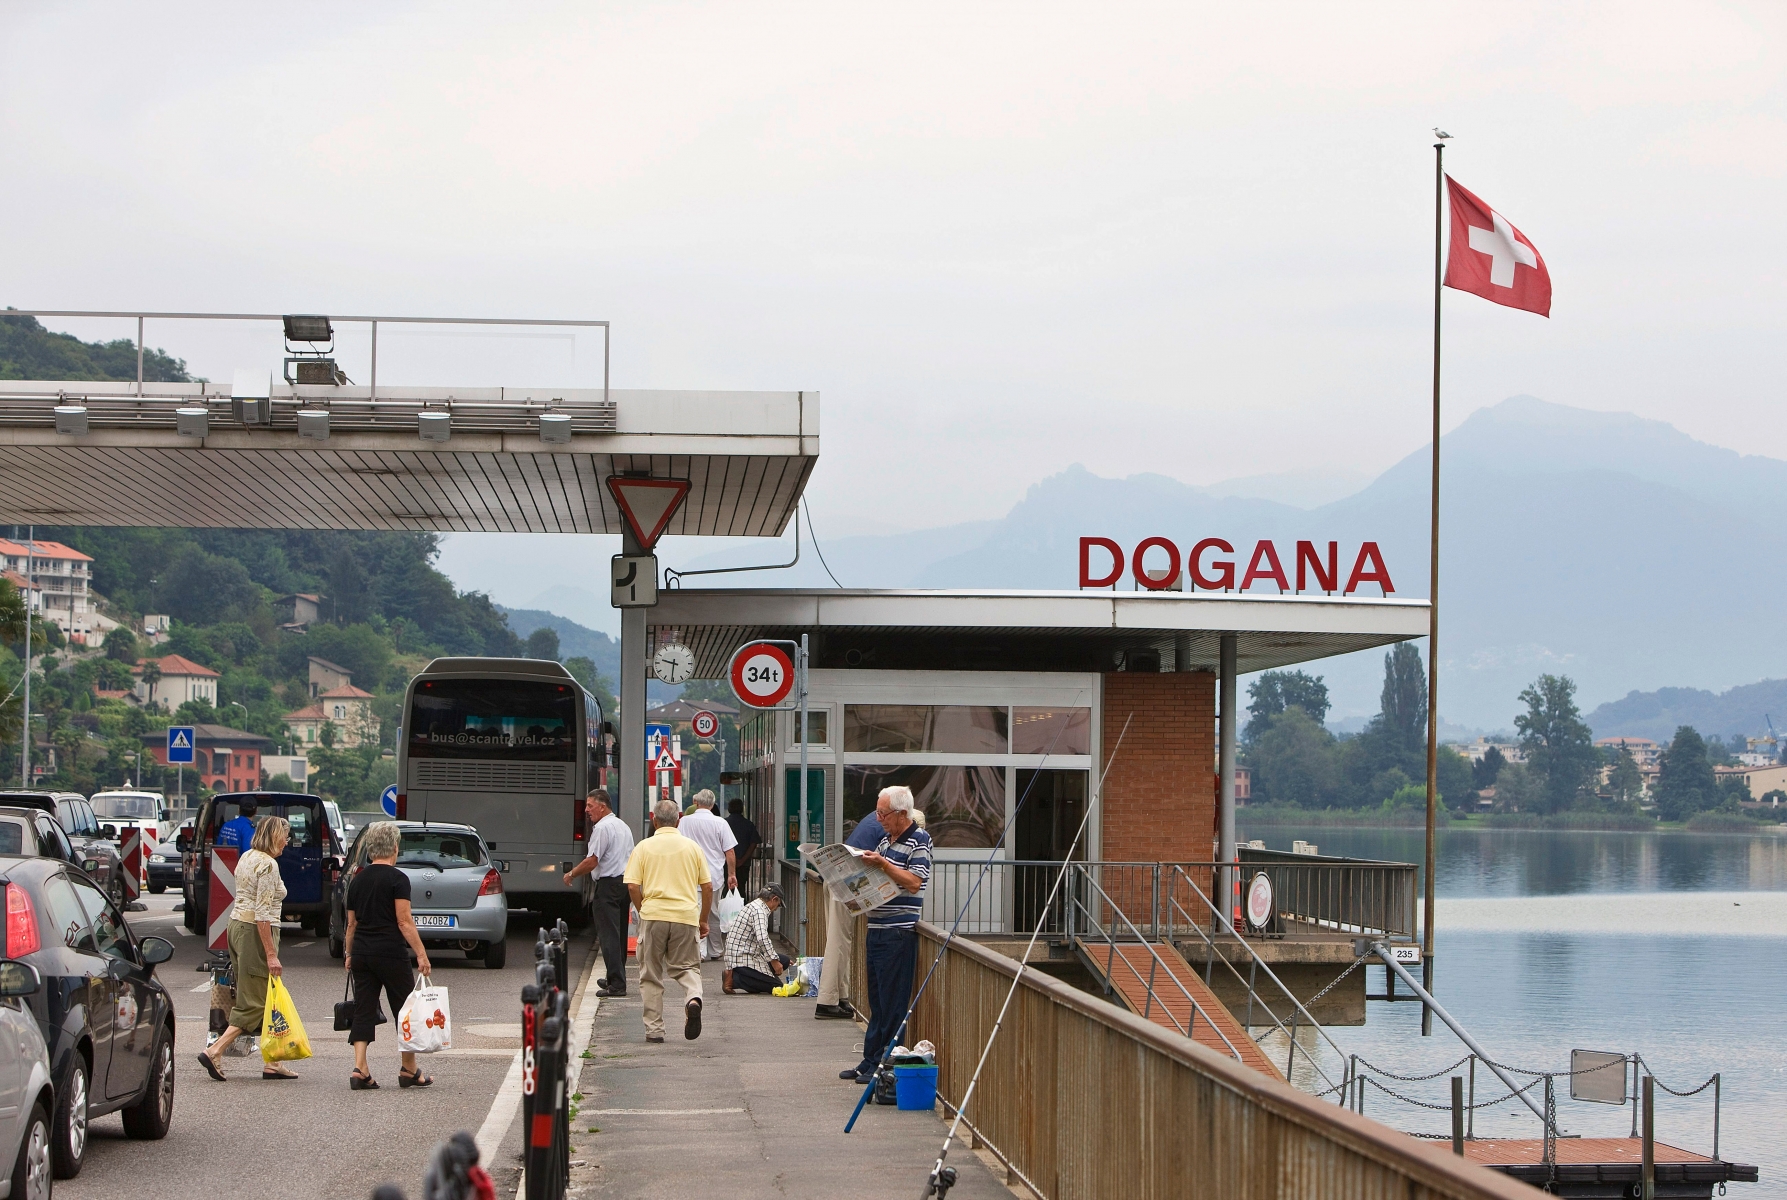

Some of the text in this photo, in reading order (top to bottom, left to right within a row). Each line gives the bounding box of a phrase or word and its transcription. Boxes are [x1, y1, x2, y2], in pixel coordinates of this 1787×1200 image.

[1079, 536, 1396, 593] DOGANA
[699, 719, 711, 729] 50
[431, 732, 555, 746] bus@scantravel.cz
[1396, 950, 1413, 959] 235
